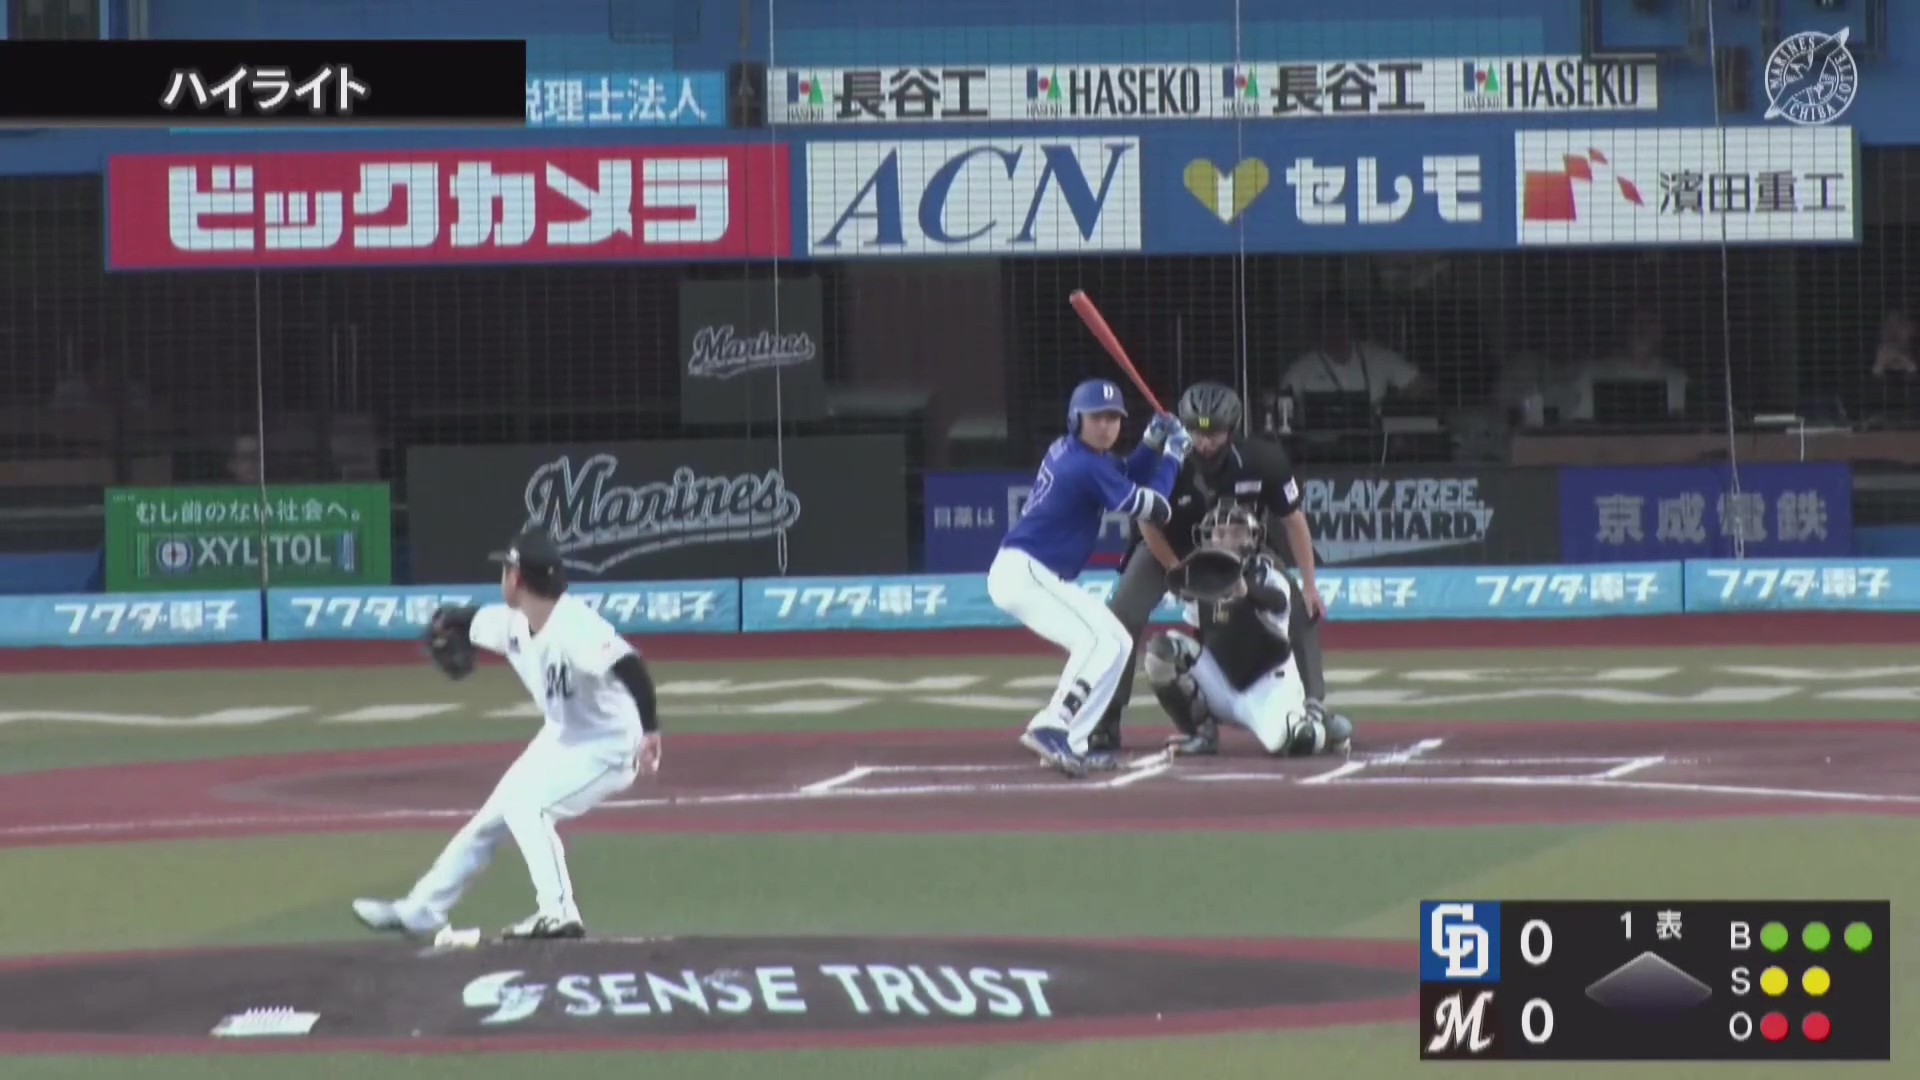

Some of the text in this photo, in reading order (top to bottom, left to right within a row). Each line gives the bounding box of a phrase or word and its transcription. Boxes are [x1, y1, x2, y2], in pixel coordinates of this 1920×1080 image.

[833, 68, 988, 119] 長谷工
[1069, 67, 1201, 115] HASEKO
[1270, 62, 1425, 113] 長谷工
[1506, 60, 1638, 108] HASEKO
[167, 156, 730, 251] ビックカメラ
[817, 142, 1135, 246] ACN
[1286, 154, 1482, 225] セレモ
[1660, 169, 1847, 216] 濱田重工
[688, 323, 816, 378] Marines
[525, 453, 801, 563] Marines
[1308, 511, 1376, 540] WIN
[1595, 490, 1828, 544] 京成電鉄
[763, 584, 948, 617] フクダ電子
[1475, 571, 1669, 606] フクダ電子
[1706, 567, 1892, 600] フクダ電子
[54, 600, 239, 634] フクダ電子
[556, 965, 1053, 1016] SENSE TRUST
